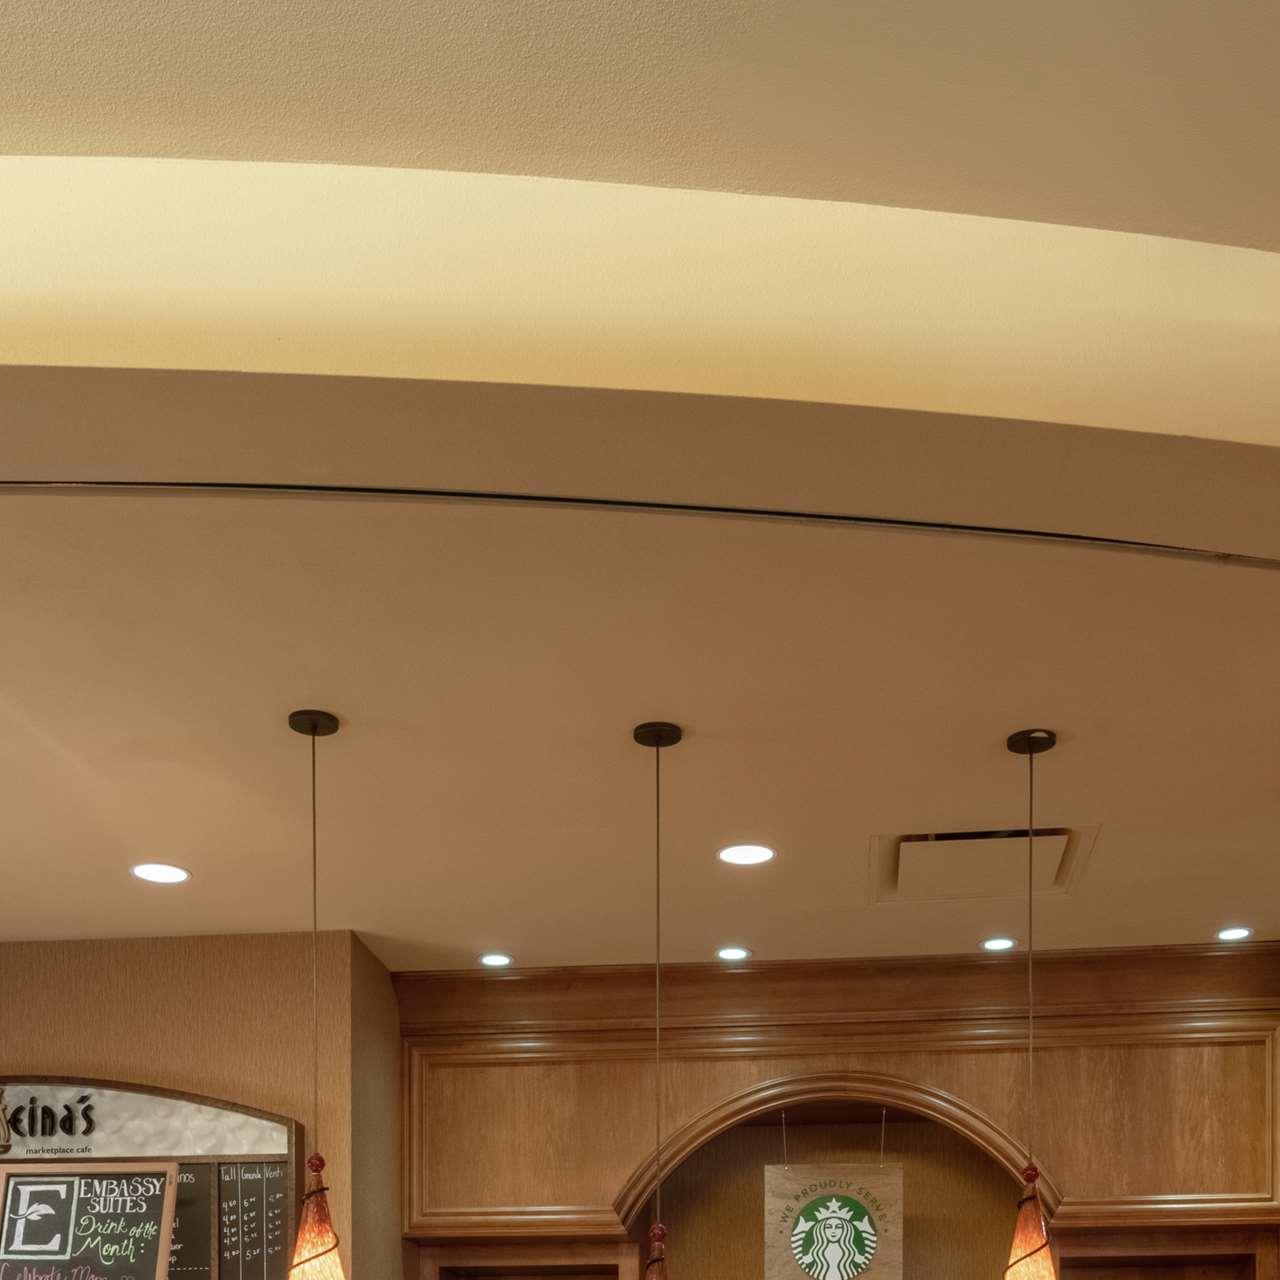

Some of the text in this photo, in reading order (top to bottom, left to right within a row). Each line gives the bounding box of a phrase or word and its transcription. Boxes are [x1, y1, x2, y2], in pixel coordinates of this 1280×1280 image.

[25, 1146, 93, 1156] marketplace cafe
[220, 1166, 237, 1181] Tall
[79, 1177, 165, 1199] EMBASSY
[86, 1197, 148, 1214] SUITES
[780, 1179, 886, 1225] WE PROUDLY SERVE
[75, 1215, 159, 1239] Drink of the
